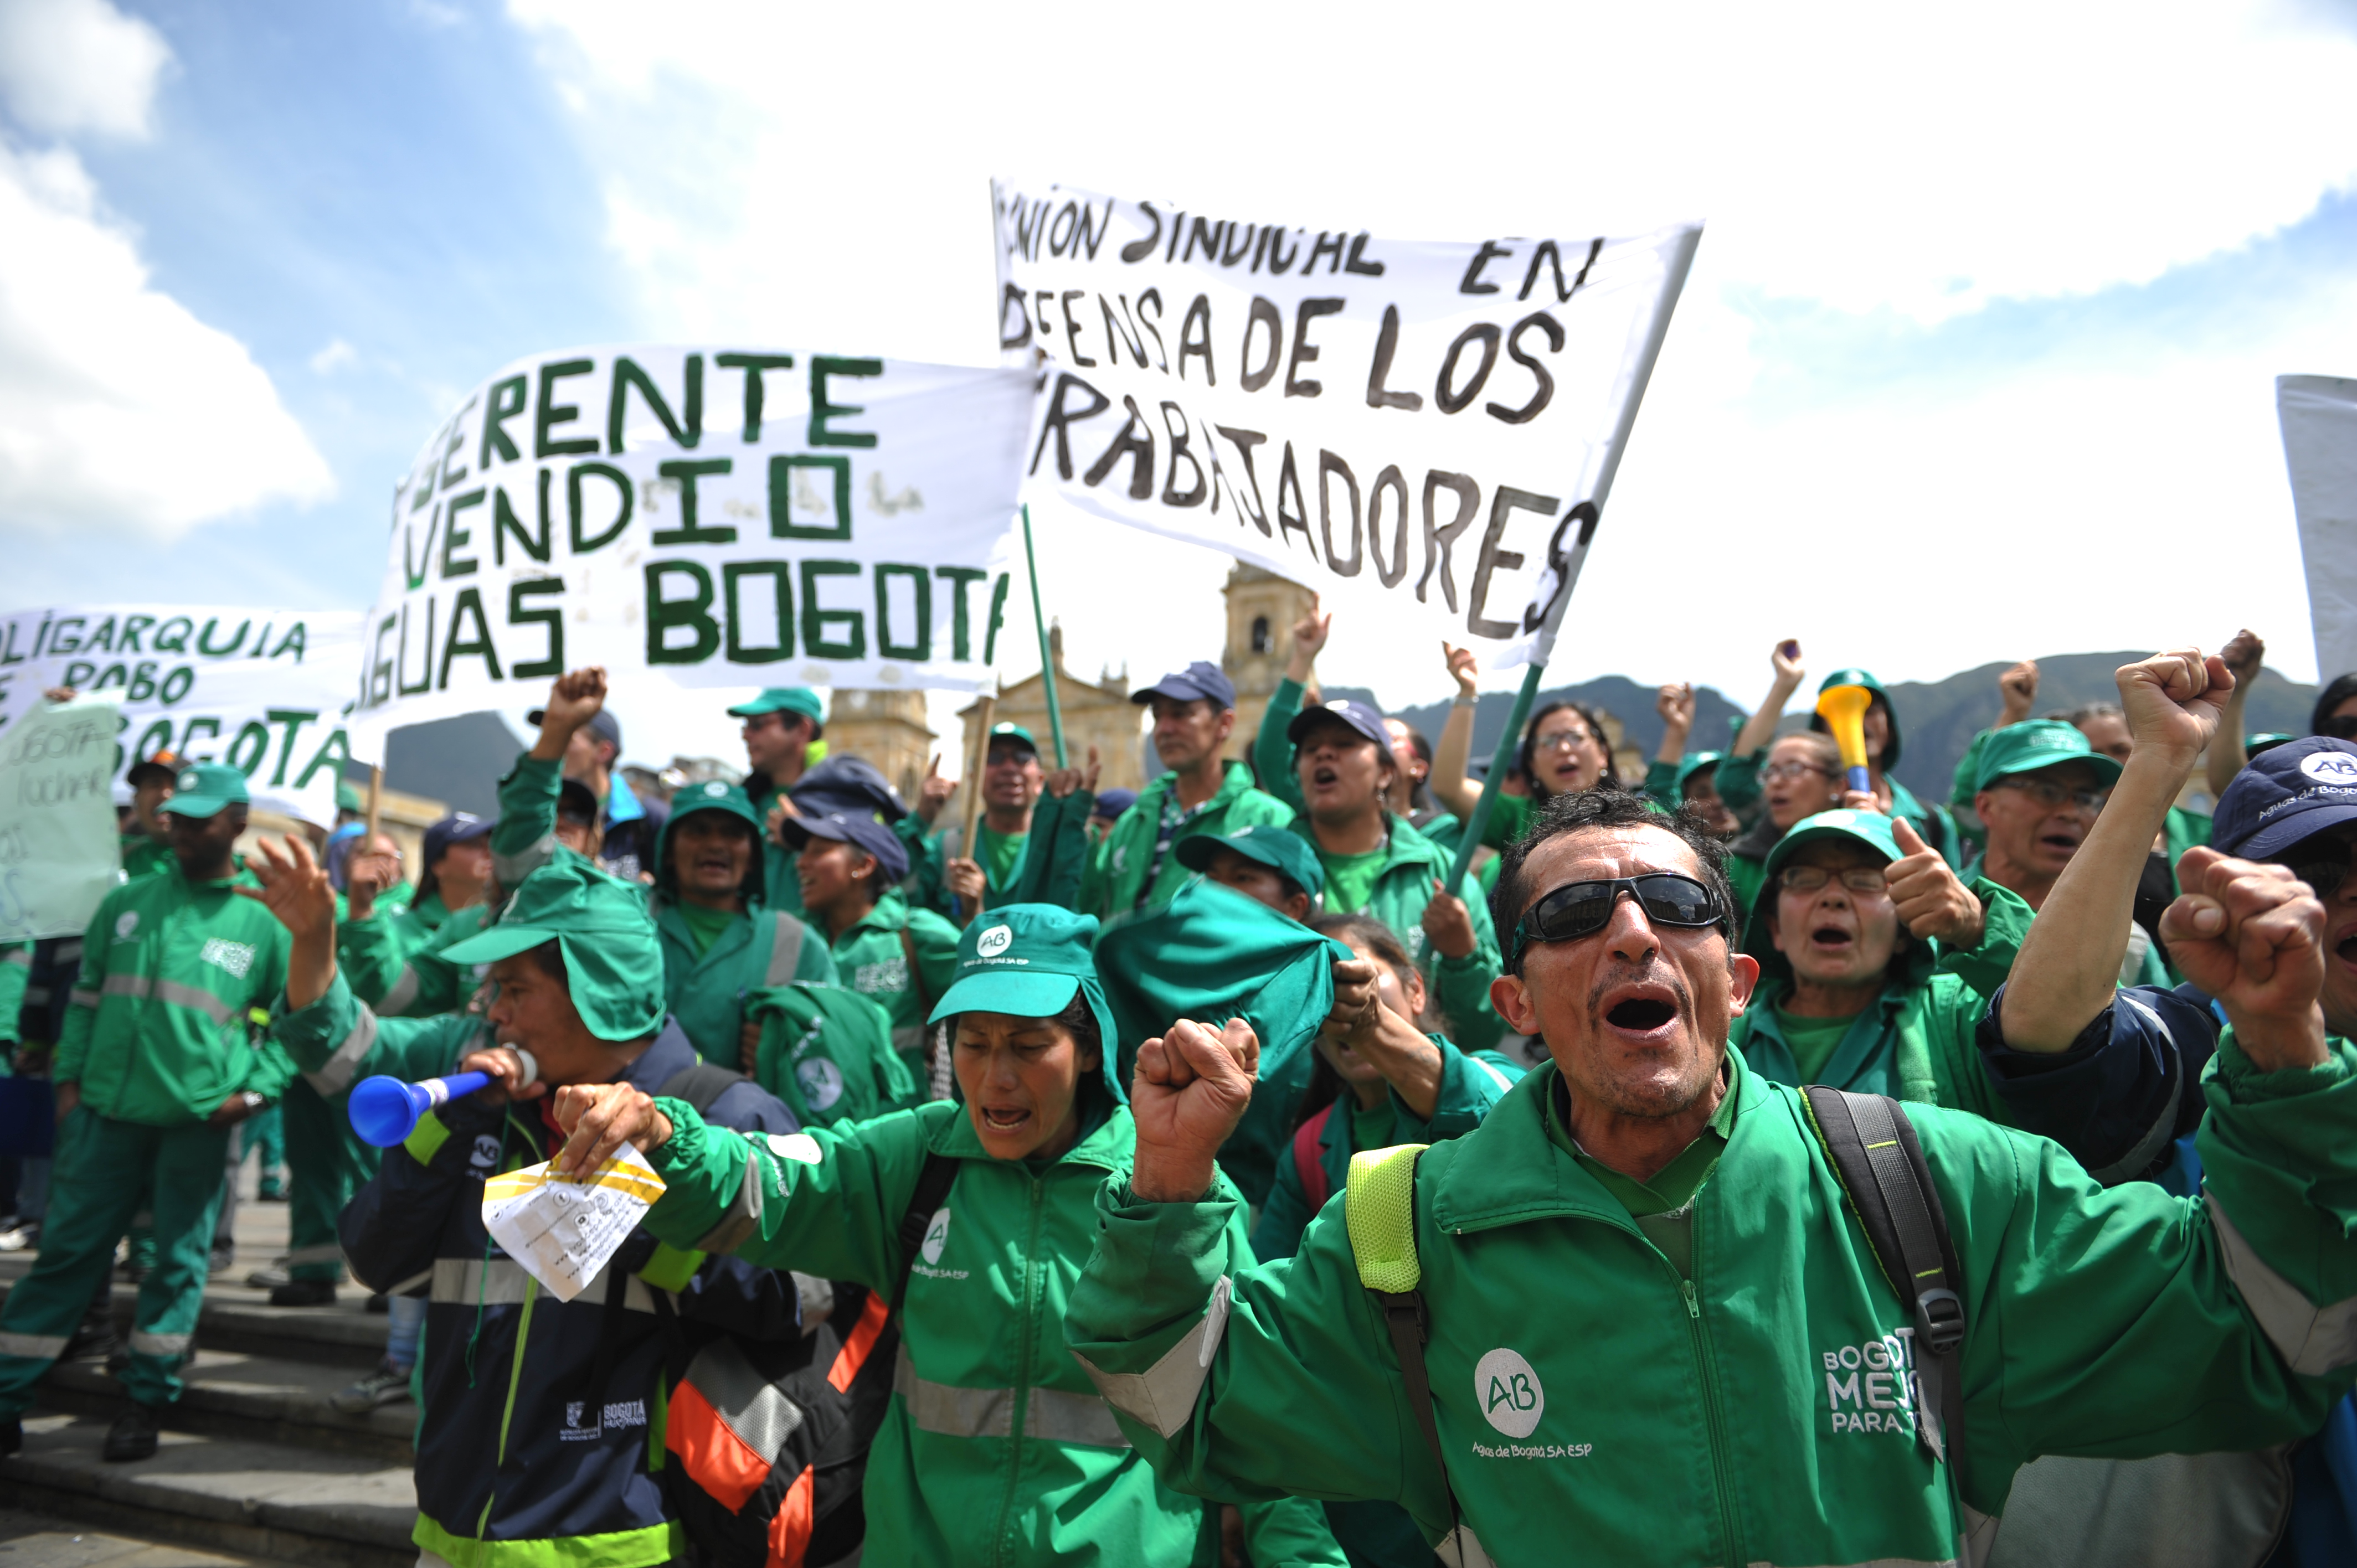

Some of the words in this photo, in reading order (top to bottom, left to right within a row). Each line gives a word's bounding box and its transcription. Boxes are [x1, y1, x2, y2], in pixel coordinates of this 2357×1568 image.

[1459, 237, 1607, 303] EN
[1240, 294, 1346, 398] DE
[1366, 302, 1566, 424] LOS
[404, 453, 853, 590] VENDIO
[1028, 370, 1599, 641] RABAJADORES
[0, 610, 307, 664] LIGARQUIA
[2258, 796, 2297, 822] Aguas
[2297, 787, 2317, 801] de
[980, 932, 1006, 950] AB
[926, 1223, 946, 1248] A
[1487, 1373, 1537, 1415] AB
[1831, 1412, 1904, 1434] PARA
[1495, 1445, 1510, 1458] de
[1510, 1443, 1546, 1461] Bogotá
[1546, 1445, 1566, 1458] SA
[1567, 1443, 1593, 1458] ESP
